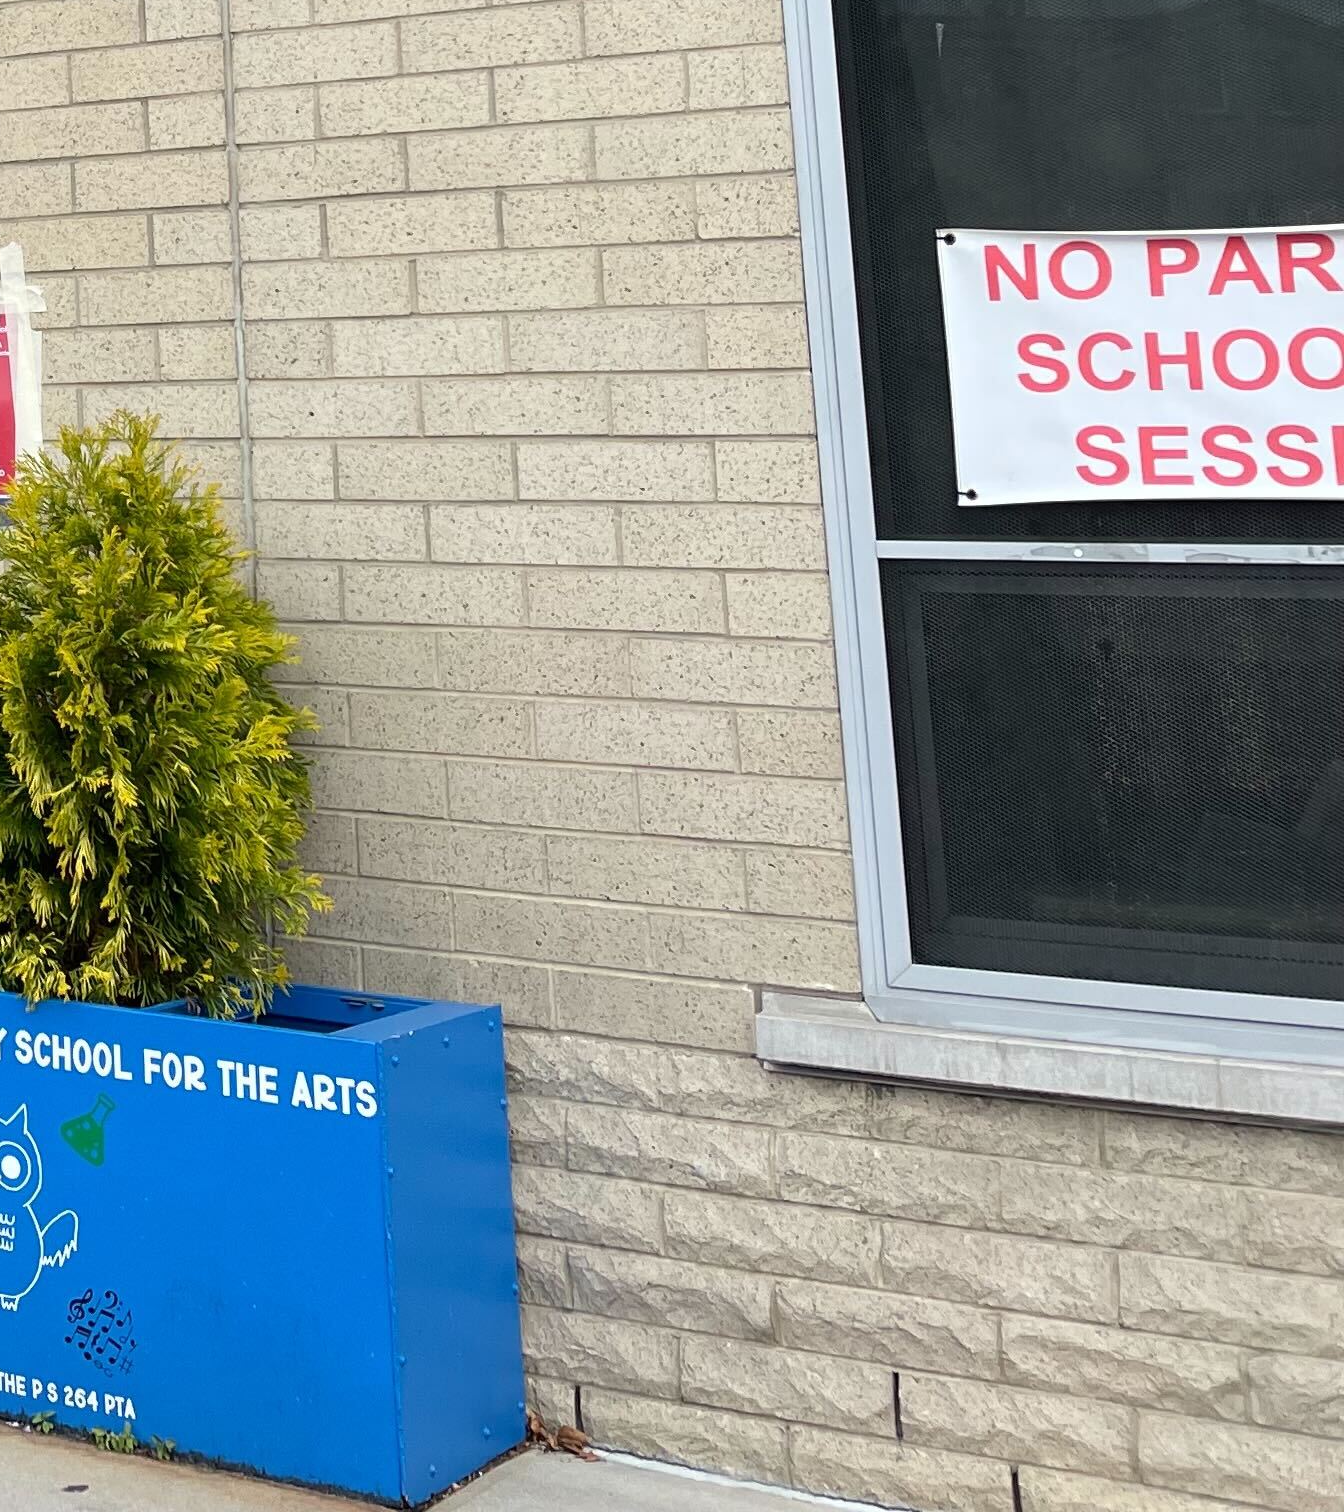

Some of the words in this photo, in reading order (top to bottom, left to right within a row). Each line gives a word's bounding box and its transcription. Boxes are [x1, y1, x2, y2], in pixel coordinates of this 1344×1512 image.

[983, 239, 1112, 302] NO
[1146, 232, 1344, 297] PAR
[1017, 326, 1344, 393] SCHOO
[14, 1029, 133, 1081] SCHOOL
[143, 1048, 207, 1091] FOR
[216, 1059, 279, 1105] THE
[291, 1071, 378, 1118] ARTS
[32, 1378, 43, 1399] P
[47, 1382, 58, 1403] S
[63, 1385, 99, 1413] 264
[104, 1393, 136, 1420] PTA
